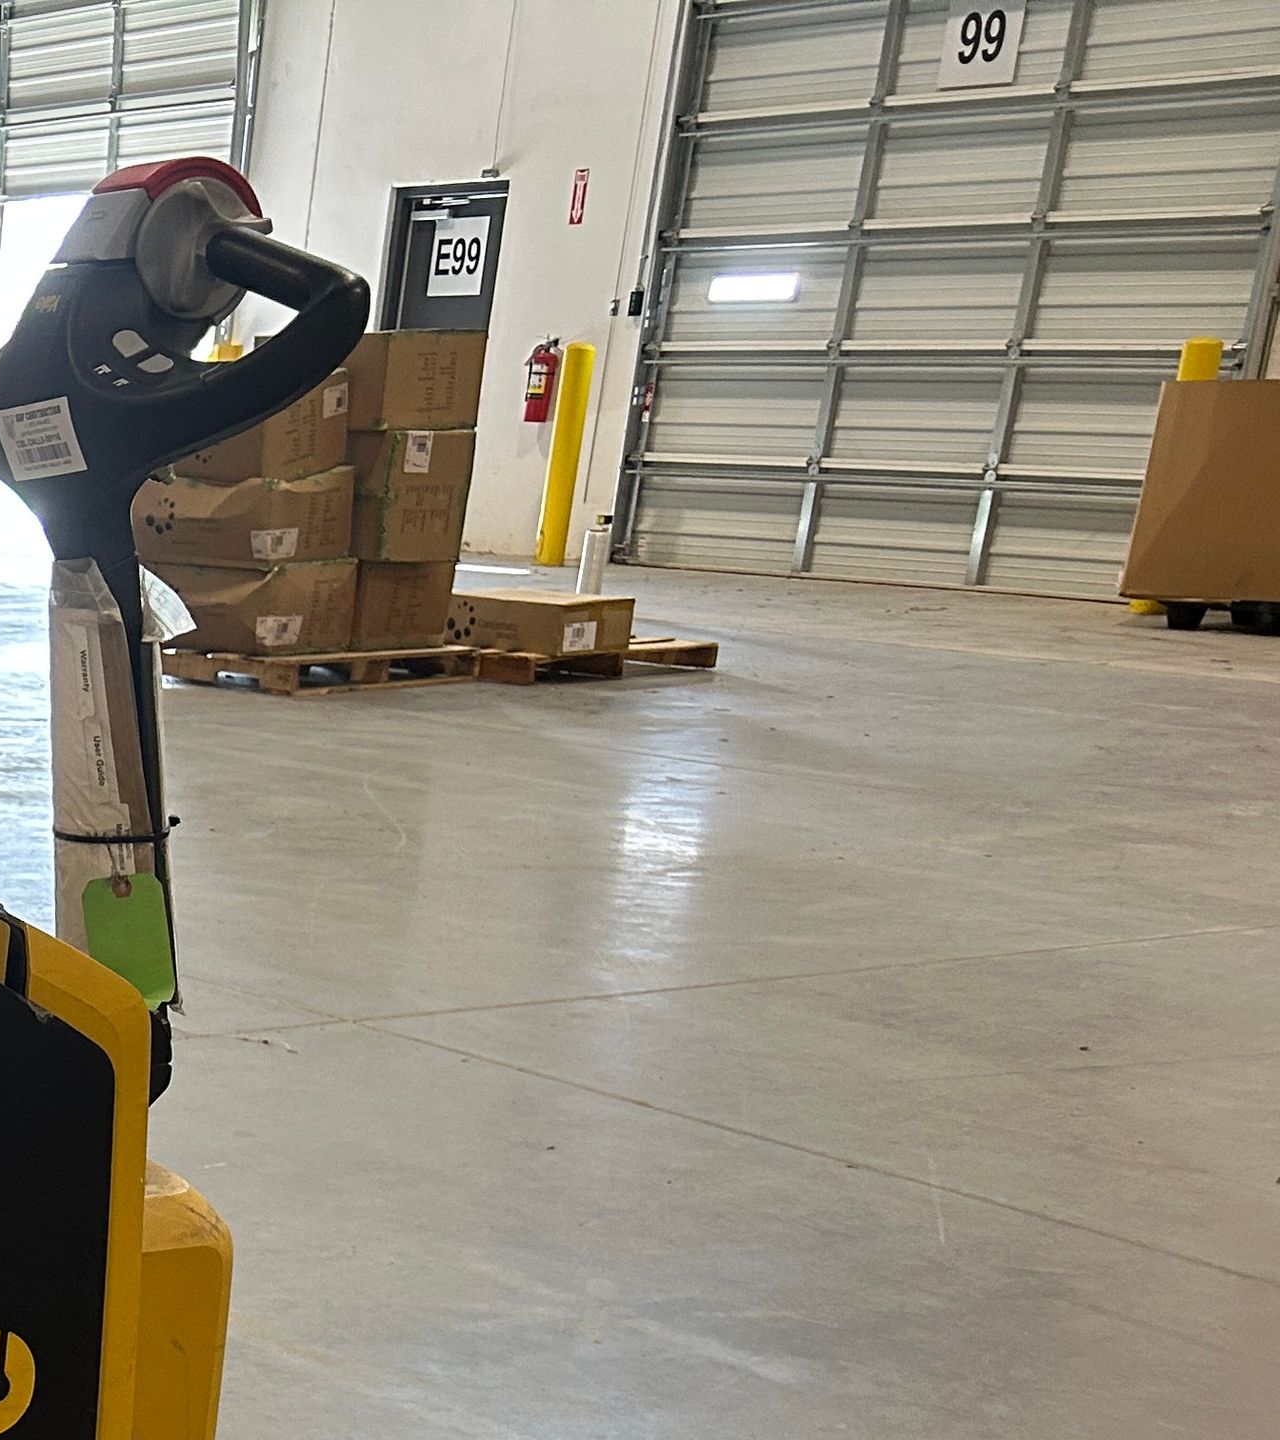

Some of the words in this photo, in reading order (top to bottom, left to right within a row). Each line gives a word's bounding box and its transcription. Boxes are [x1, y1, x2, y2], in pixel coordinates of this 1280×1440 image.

[958, 9, 1007, 65] 99
[434, 236, 481, 276] E99
[79, 649, 91, 693] Warranty
[92, 735, 102, 757] User
[96, 759, 106, 787] Guide
